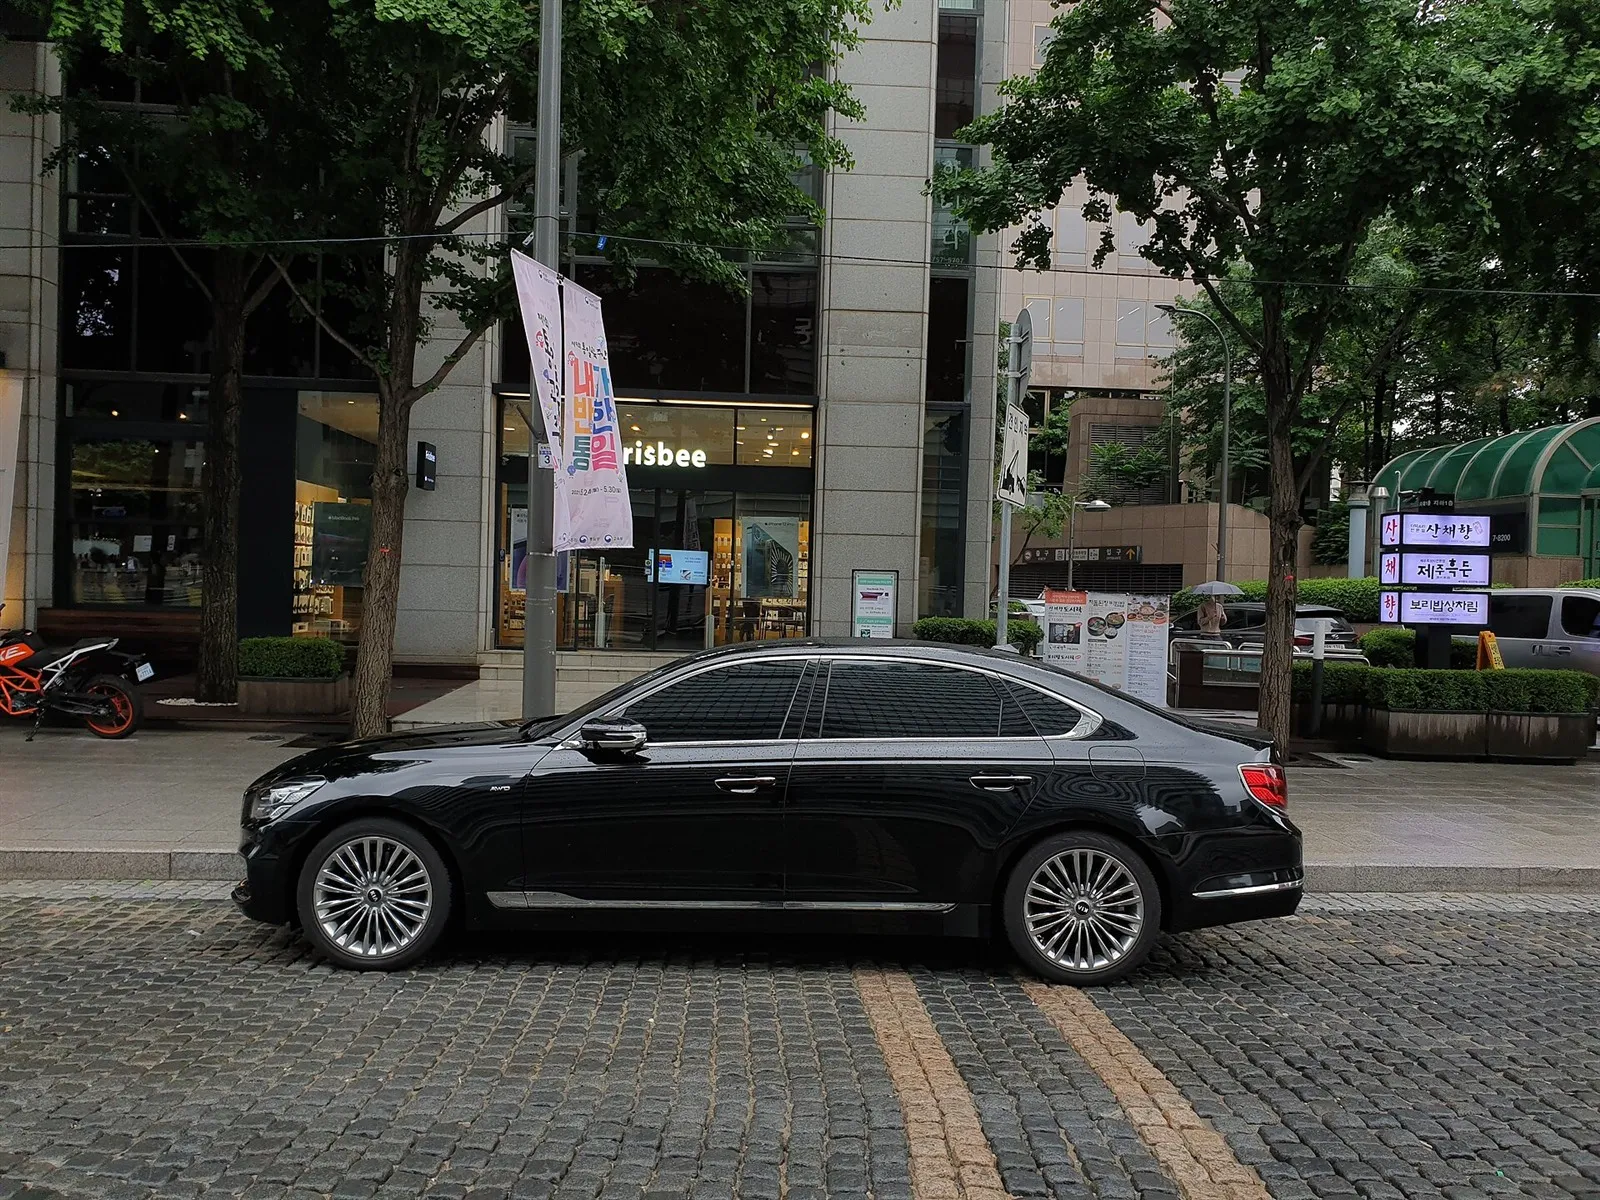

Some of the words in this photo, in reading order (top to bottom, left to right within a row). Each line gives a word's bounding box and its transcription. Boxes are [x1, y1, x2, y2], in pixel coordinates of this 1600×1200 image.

[574, 357, 610, 398] 내가
[574, 396, 613, 435] 반한
[544, 454, 552, 464] 3
[573, 433, 618, 471] 통일
[623, 440, 707, 468] risbee
[1386, 518, 1398, 543] 산
[1426, 522, 1473, 540] 산채향
[1385, 556, 1396, 580] 채
[1384, 594, 1396, 619] 향
[1410, 599, 1478, 613] 보리밥상차림
